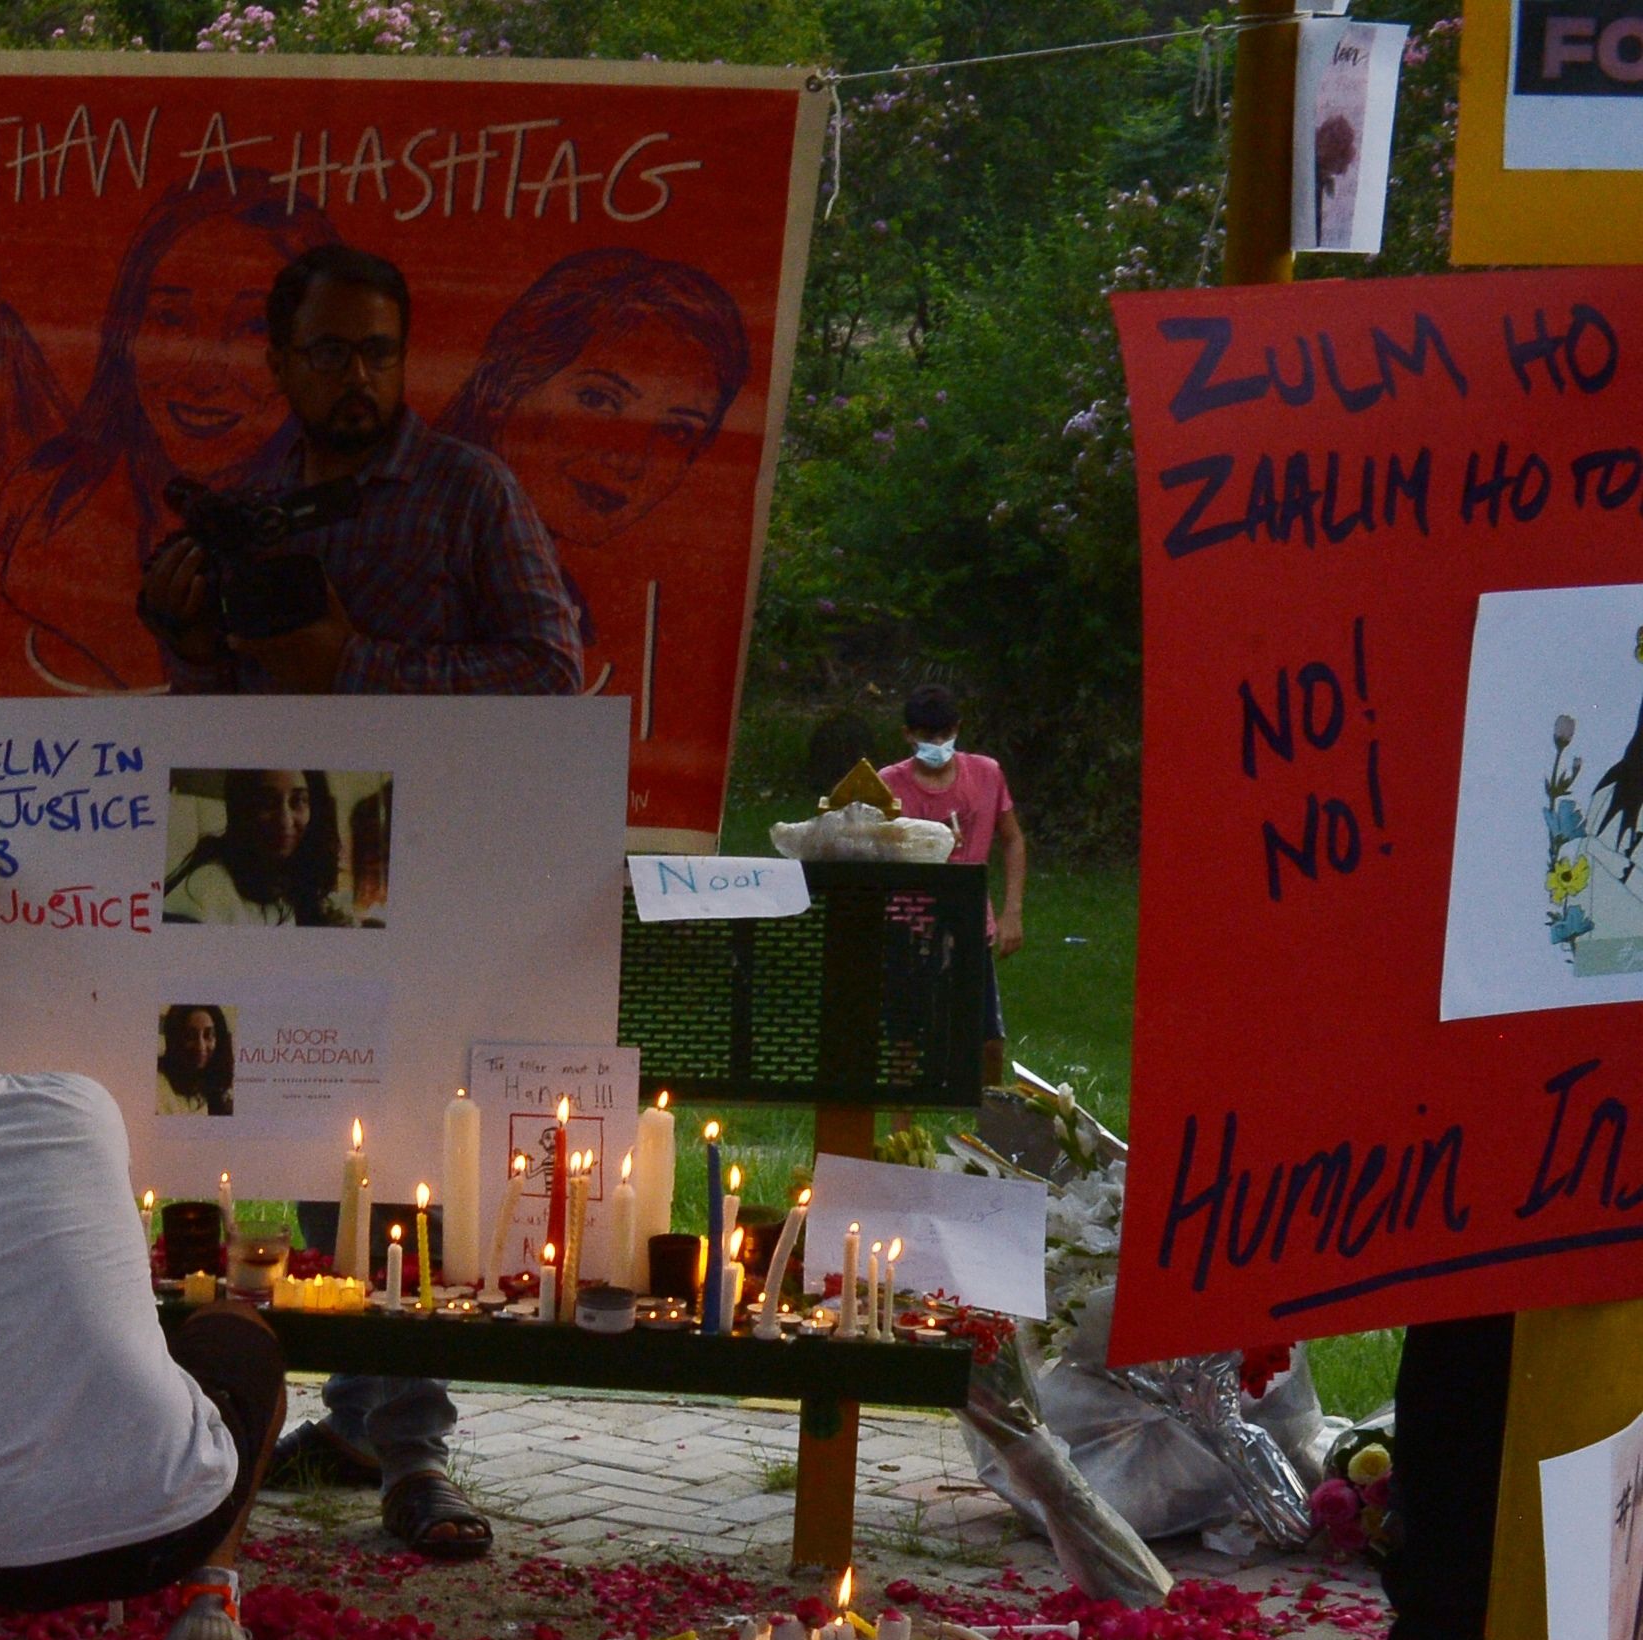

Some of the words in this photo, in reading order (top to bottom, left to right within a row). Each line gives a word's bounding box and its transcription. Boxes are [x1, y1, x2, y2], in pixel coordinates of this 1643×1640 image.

[1541, 15, 1643, 83] FO
[179, 111, 274, 195] A
[270, 118, 702, 222] HASHTAG
[1155, 310, 1468, 424] ZULM
[1502, 303, 1619, 396] HO
[1158, 446, 1432, 561] ZAALIM
[1459, 440, 1552, 529] HO
[1237, 616, 1377, 779] NO!
[91, 741, 144, 777] IN
[1261, 739, 1394, 901] NO!
[657, 861, 773, 896] Noor
[239, 1047, 374, 1065] MUKADDAM
[276, 1027, 339, 1046] NOOR
[1157, 1103, 1471, 1292] Humein
